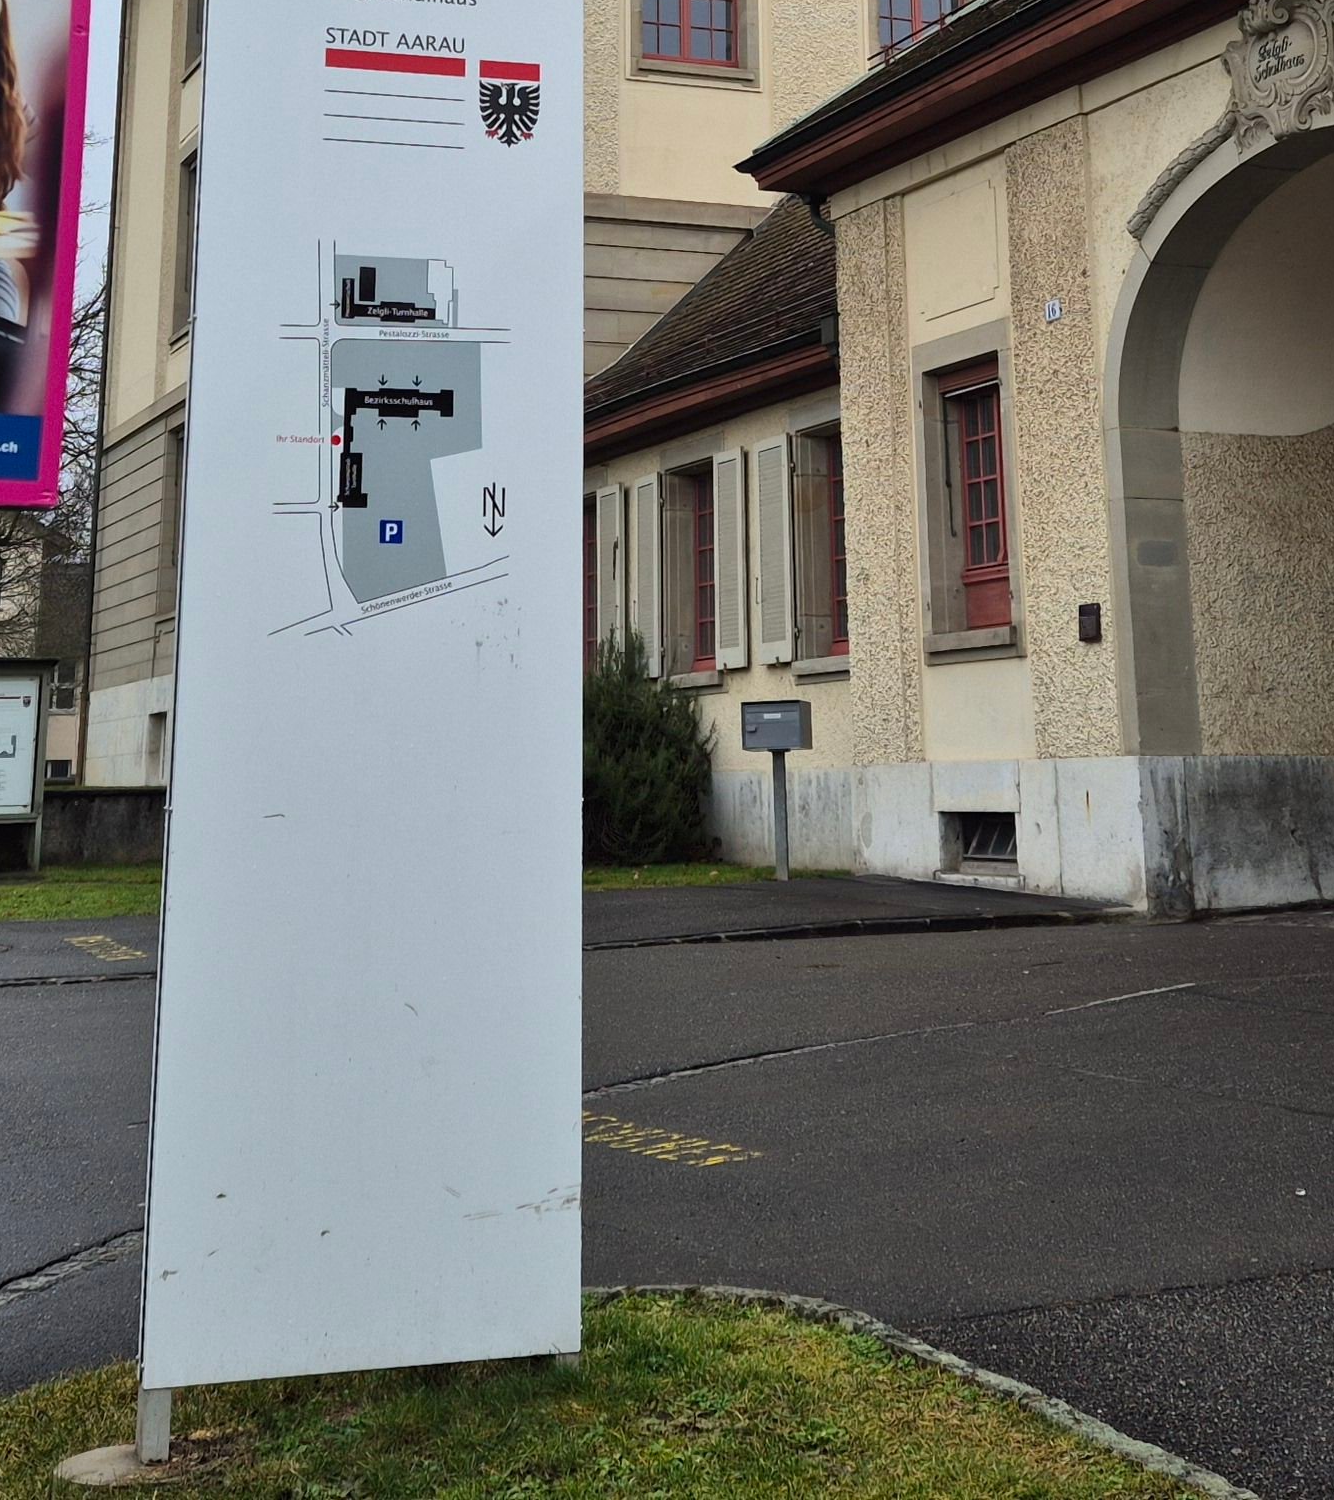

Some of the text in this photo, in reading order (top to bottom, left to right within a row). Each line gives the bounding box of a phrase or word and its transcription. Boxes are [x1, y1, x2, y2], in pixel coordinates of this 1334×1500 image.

[325, 27, 466, 54] STADT AARAU
[364, 396, 434, 406] Bezirksschulhaus
[276, 435, 325, 444] Ihr Standort
[385, 523, 398, 542] P
